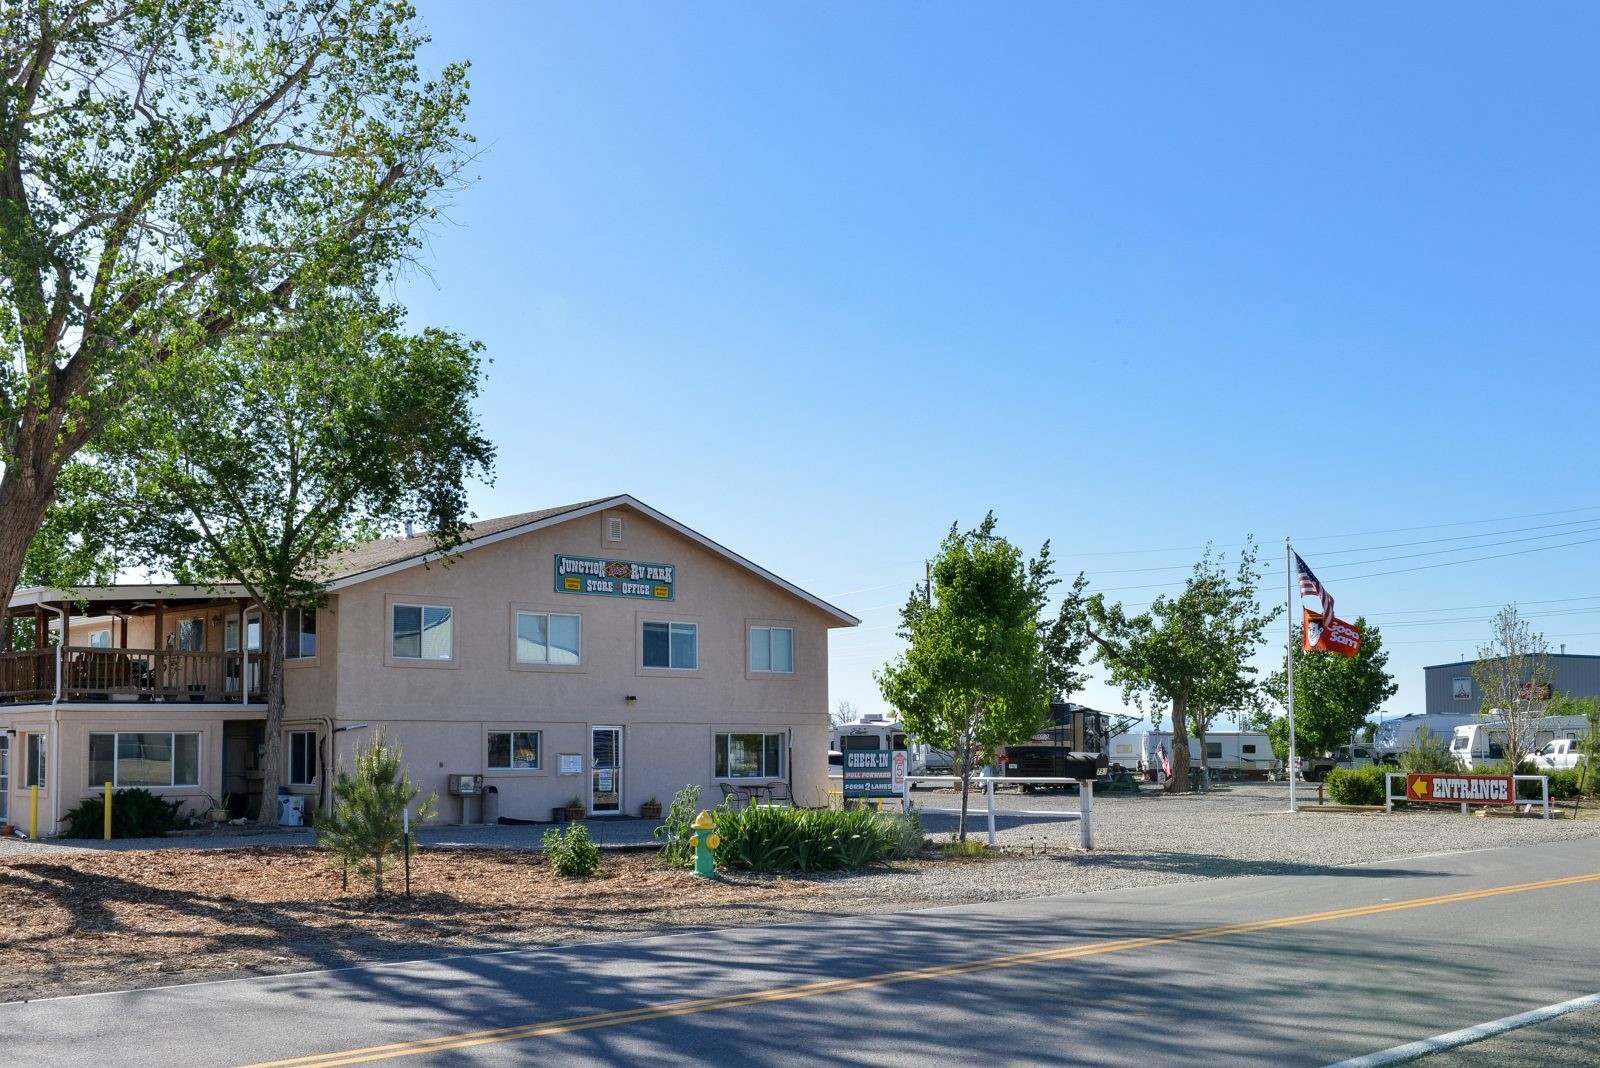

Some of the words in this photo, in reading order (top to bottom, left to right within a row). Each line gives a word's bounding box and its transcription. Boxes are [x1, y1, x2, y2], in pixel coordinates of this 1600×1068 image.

[559, 557, 606, 578] JUNCTION
[630, 564, 645, 580] RV
[647, 566, 672, 583] PARK
[587, 579, 613, 592] STORE
[622, 582, 650, 595] OFFICE
[1329, 631, 1358, 649] Sam
[848, 753, 888, 767] CHECK-IN
[896, 765, 902, 776] 5
[865, 783, 870, 791] 2
[1432, 777, 1508, 800] ENTRANCE
